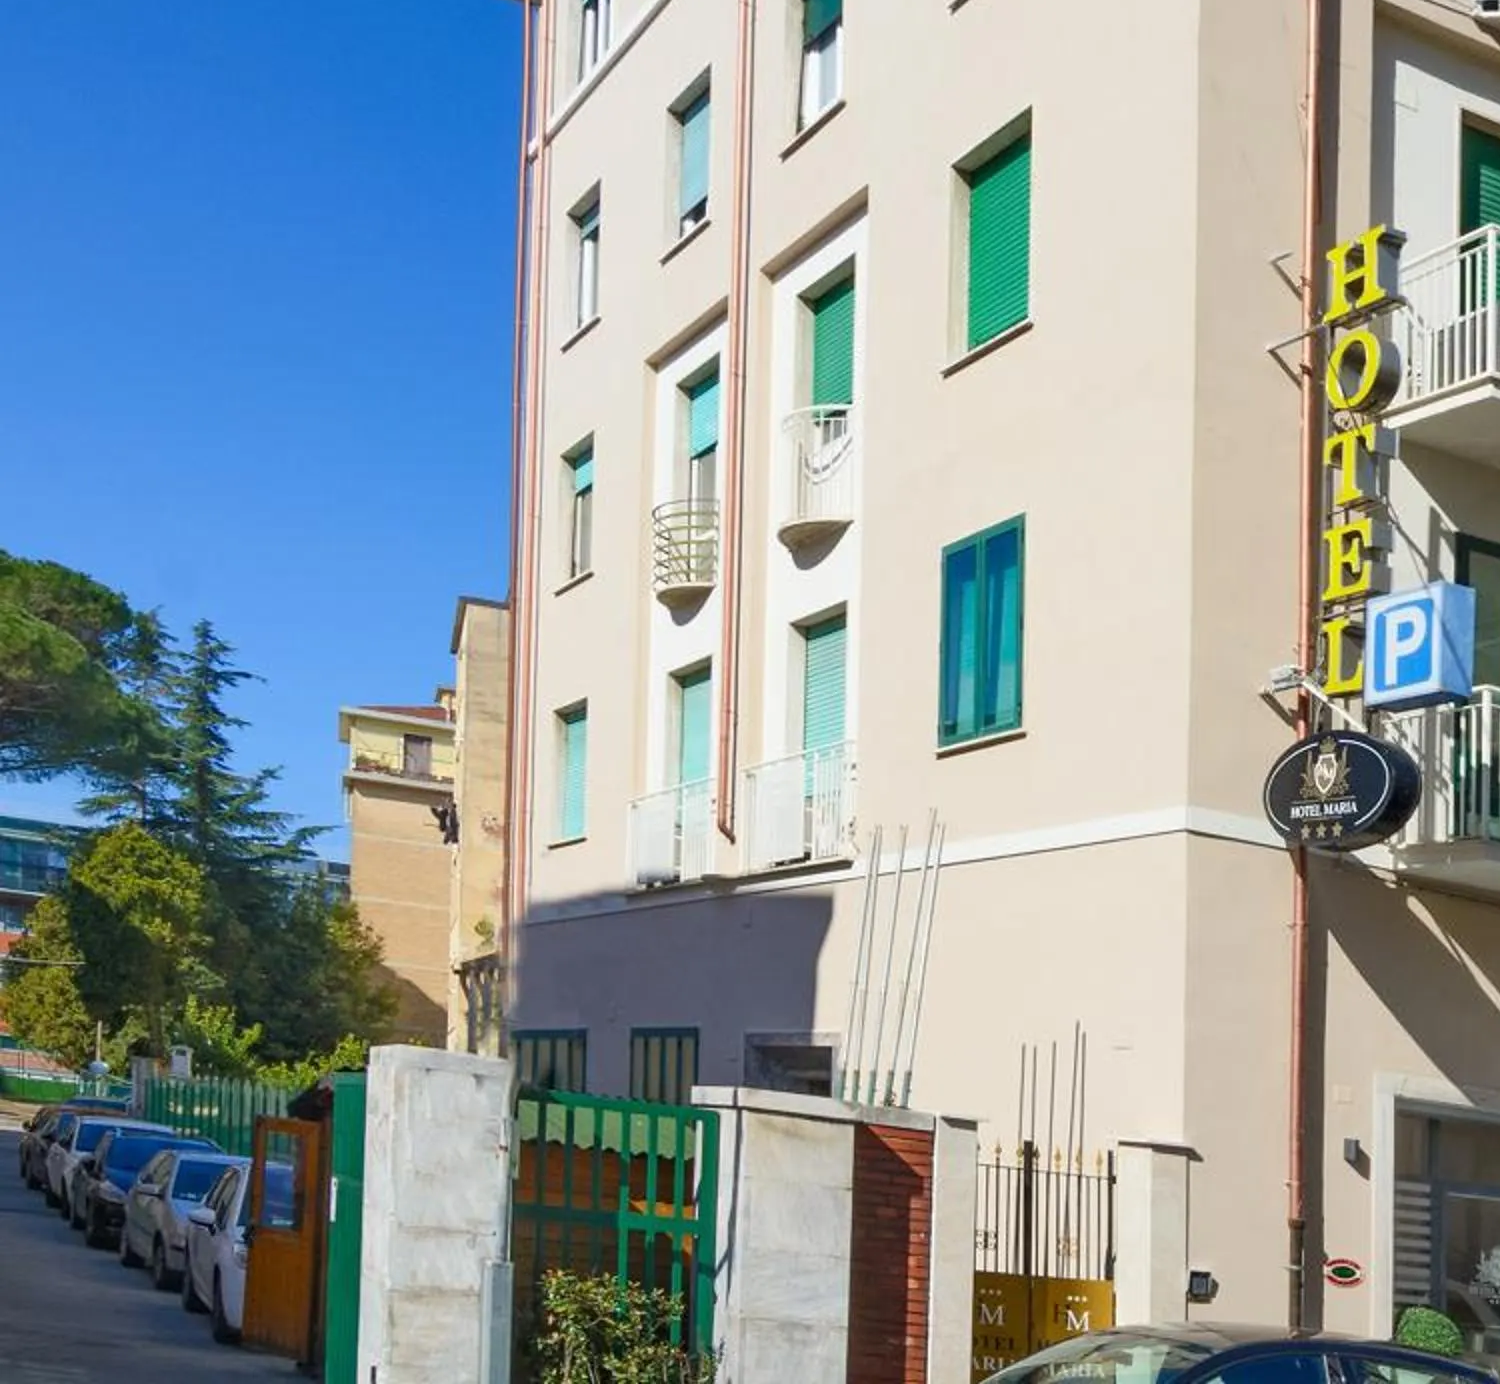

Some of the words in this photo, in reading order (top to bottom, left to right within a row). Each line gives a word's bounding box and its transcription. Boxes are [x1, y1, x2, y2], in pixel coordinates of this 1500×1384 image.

[1323, 224, 1388, 697] HOTEL
[1385, 604, 1426, 687] P
[1290, 804, 1322, 819] HOTEL
[1323, 800, 1359, 815] MARIA
